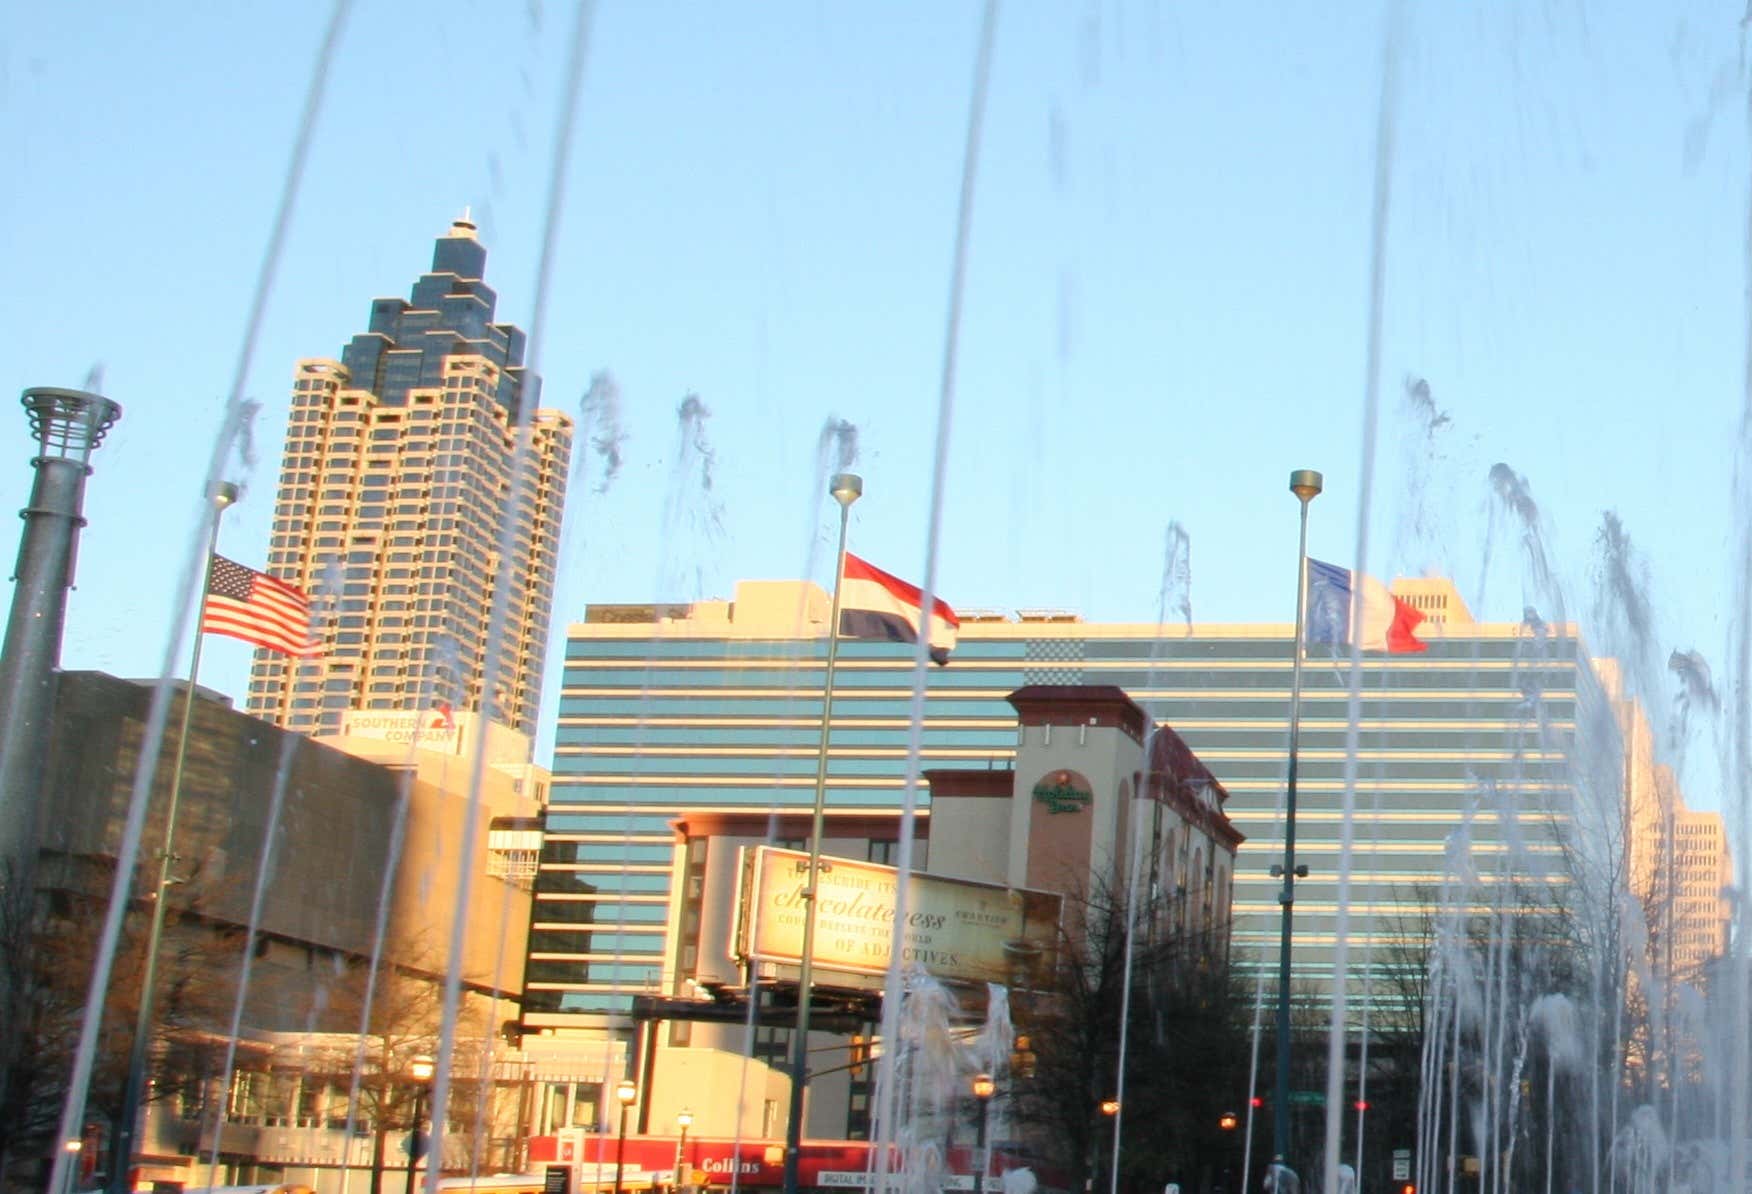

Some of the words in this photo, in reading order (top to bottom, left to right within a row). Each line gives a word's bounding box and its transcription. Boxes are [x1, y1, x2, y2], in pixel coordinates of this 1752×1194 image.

[351, 717, 426, 729] SOUTHERN
[385, 730, 456, 742] COMPANY
[835, 938, 856, 952] OF
[702, 1157, 760, 1175] Collins
